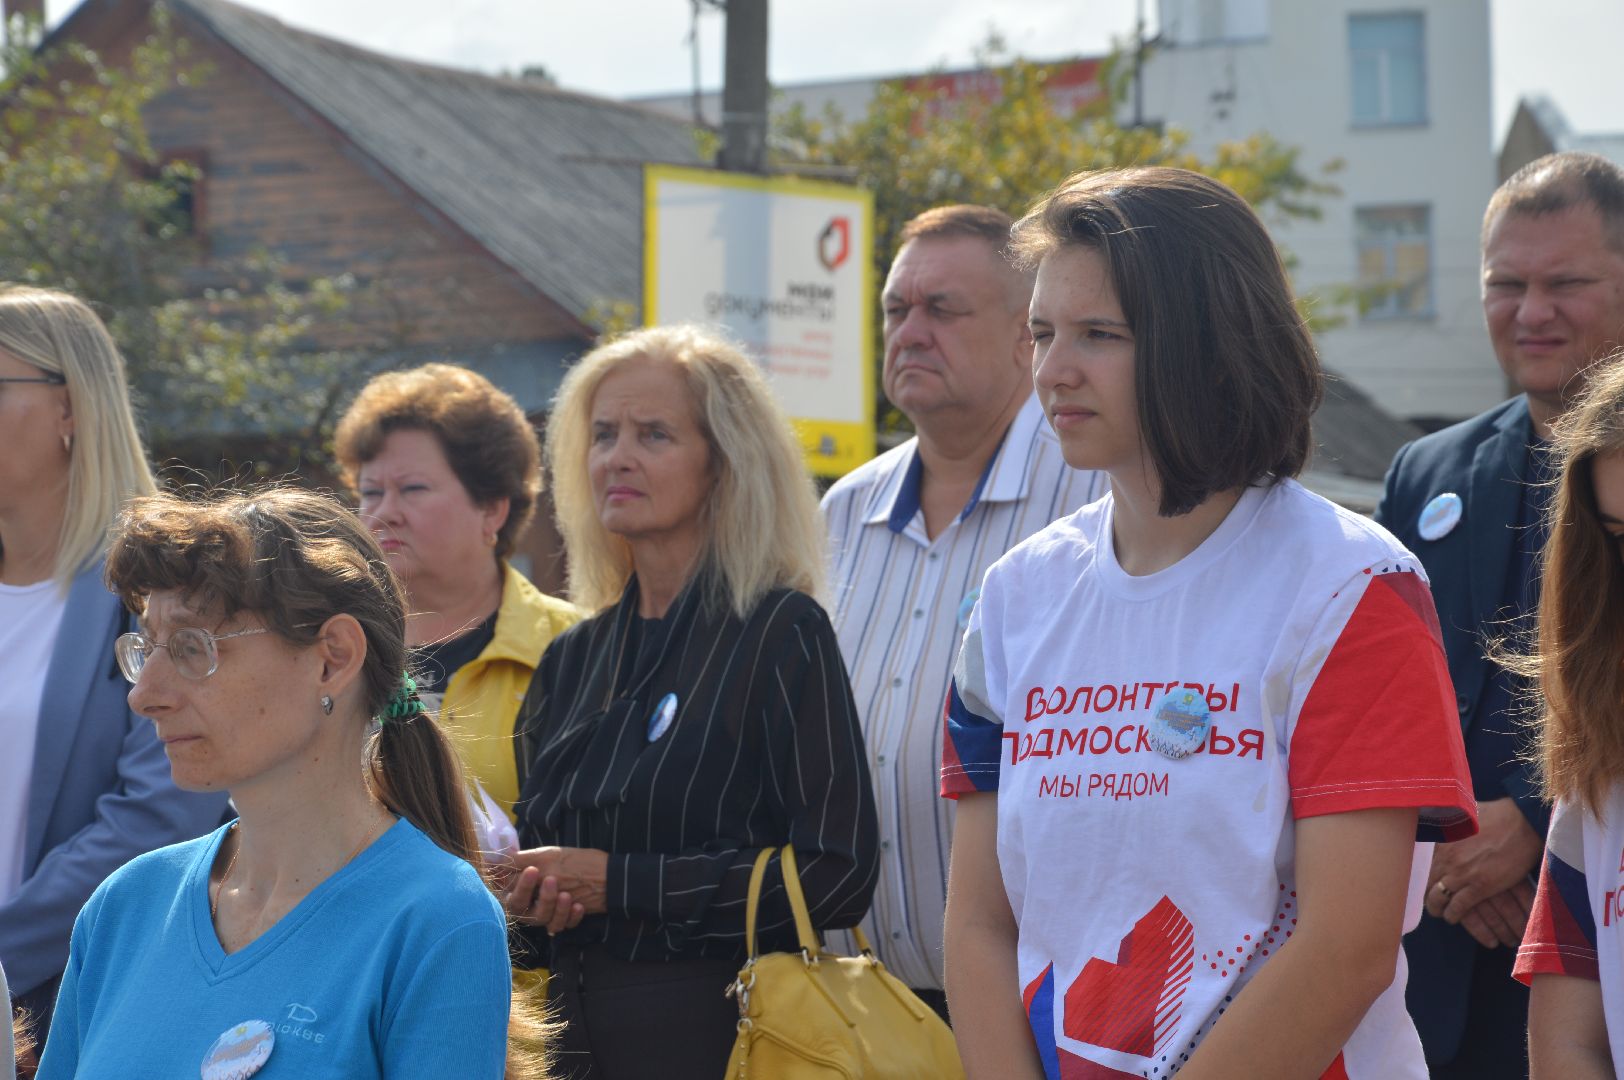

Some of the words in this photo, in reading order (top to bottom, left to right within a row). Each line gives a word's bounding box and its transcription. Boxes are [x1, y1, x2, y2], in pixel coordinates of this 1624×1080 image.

[1024, 681, 1240, 722] ВОЛОНТЫ
[1002, 724, 1265, 765] ПОДМОСКЬЯ
[1039, 774, 1082, 798] МЫ
[1088, 772, 1169, 801] РЯДОМ
